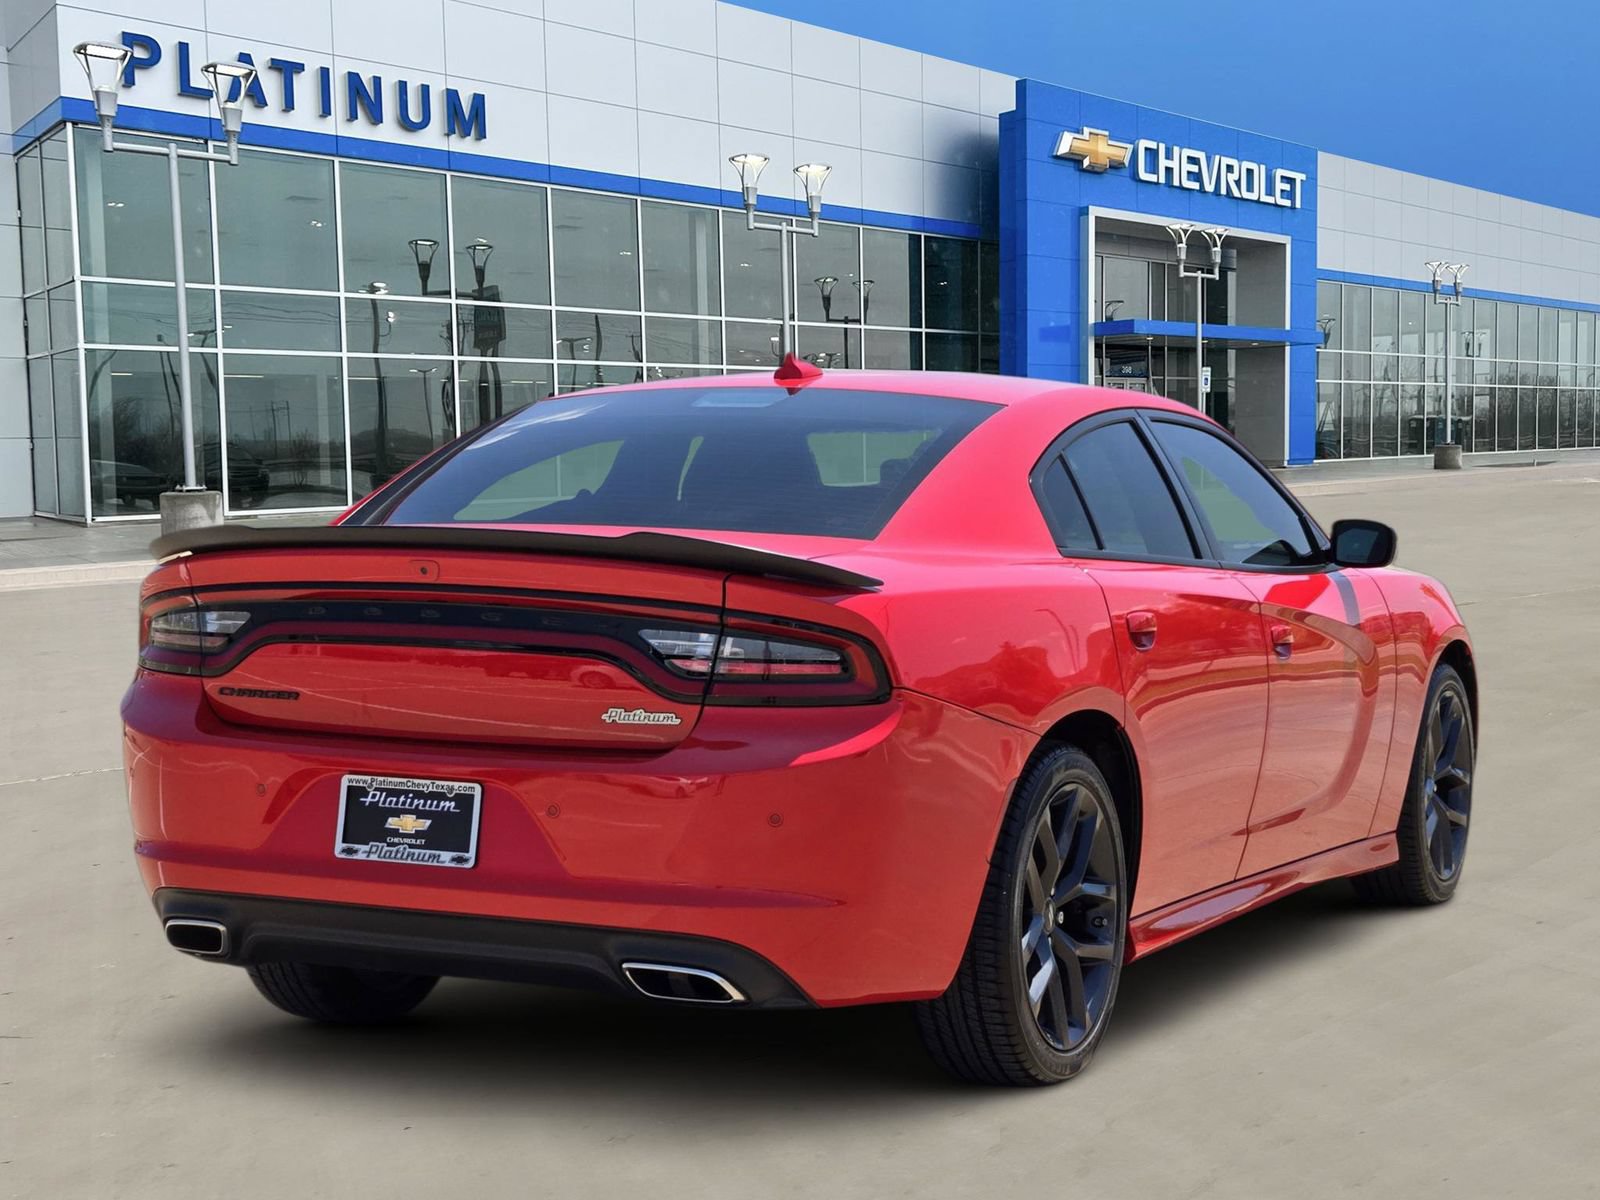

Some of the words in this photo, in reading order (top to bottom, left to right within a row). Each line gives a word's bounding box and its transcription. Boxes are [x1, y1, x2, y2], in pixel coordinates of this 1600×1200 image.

[121, 31, 487, 140] PLATINUM
[1136, 139, 1307, 209] CHEVROLET
[219, 687, 300, 701] CHARGER
[602, 708, 681, 725] Platinum
[360, 791, 461, 813] Platinum
[386, 836, 426, 845] CHEVROLET
[361, 843, 447, 864] Platinum
